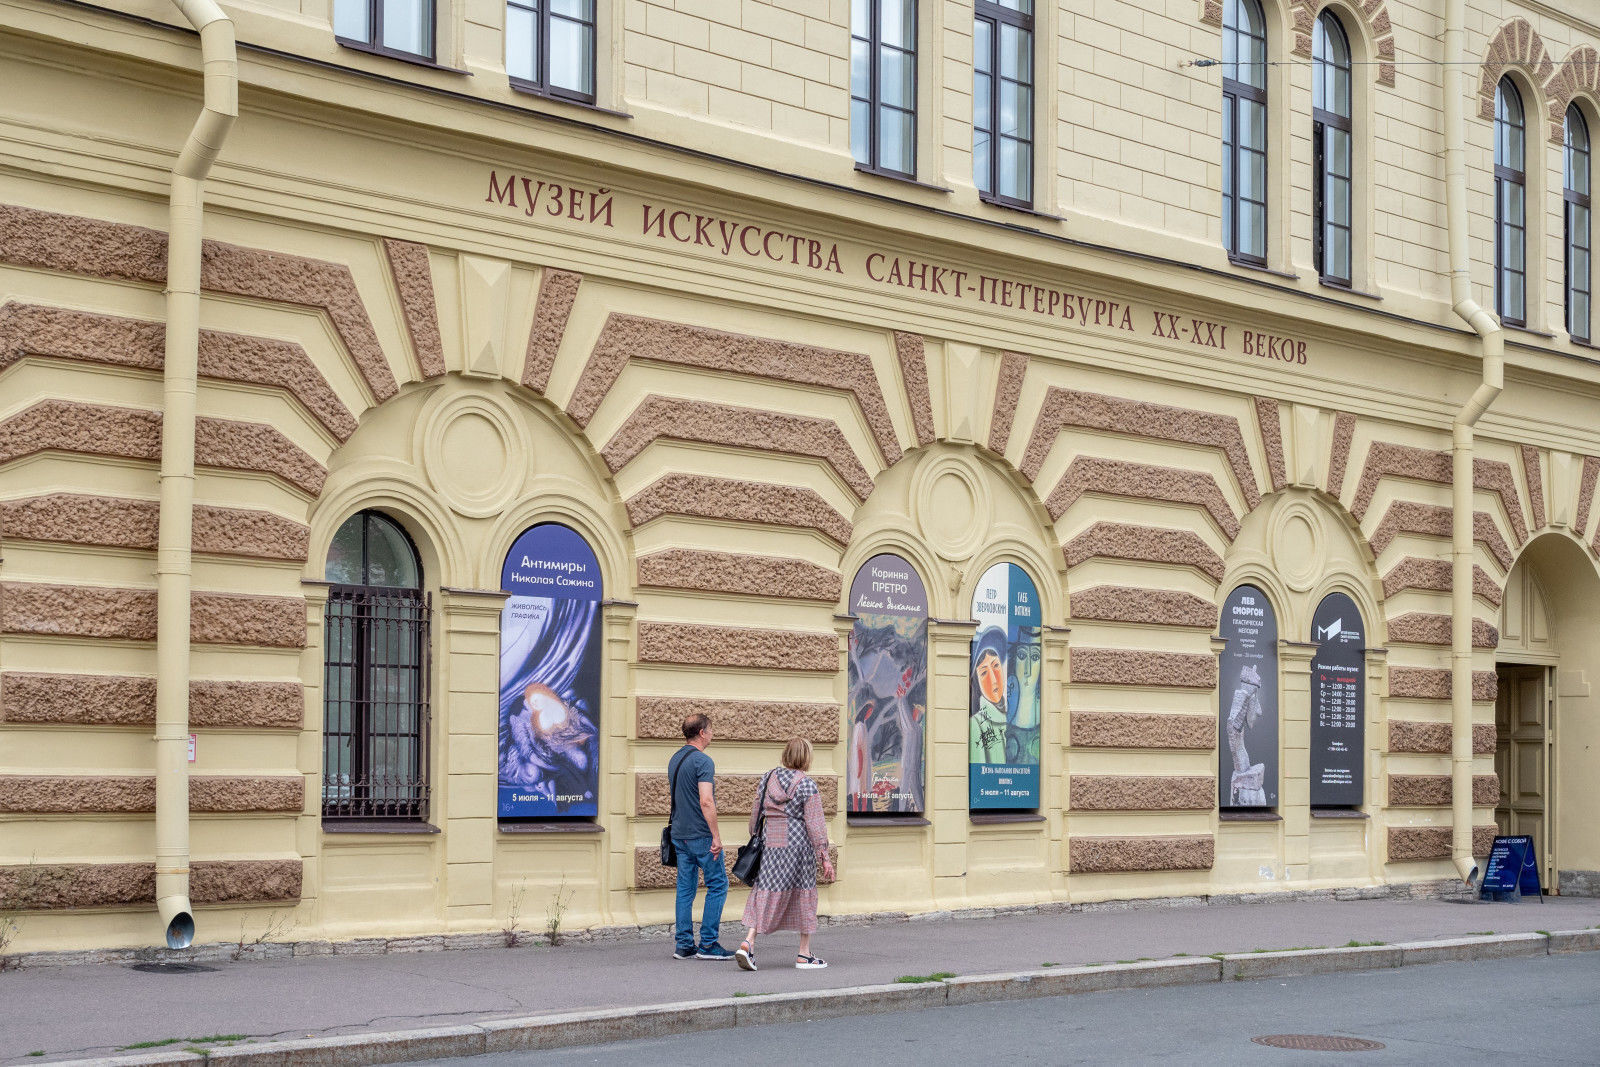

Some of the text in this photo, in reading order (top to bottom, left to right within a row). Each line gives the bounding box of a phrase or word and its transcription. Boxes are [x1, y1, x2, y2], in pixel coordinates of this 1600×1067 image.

[485, 171, 614, 228] МУЗЕЙ
[642, 204, 845, 275] ИСКУССТВА
[864, 252, 1135, 332] САНКТ-ПЕТЕРБУРГА
[1242, 330, 1308, 365] ВЕКОВ
[521, 556, 586, 574] Антимиры
[511, 572, 594, 588] Николая Сажина
[872, 567, 908, 580] Коринна
[872, 582, 908, 594] ПРЕТРО
